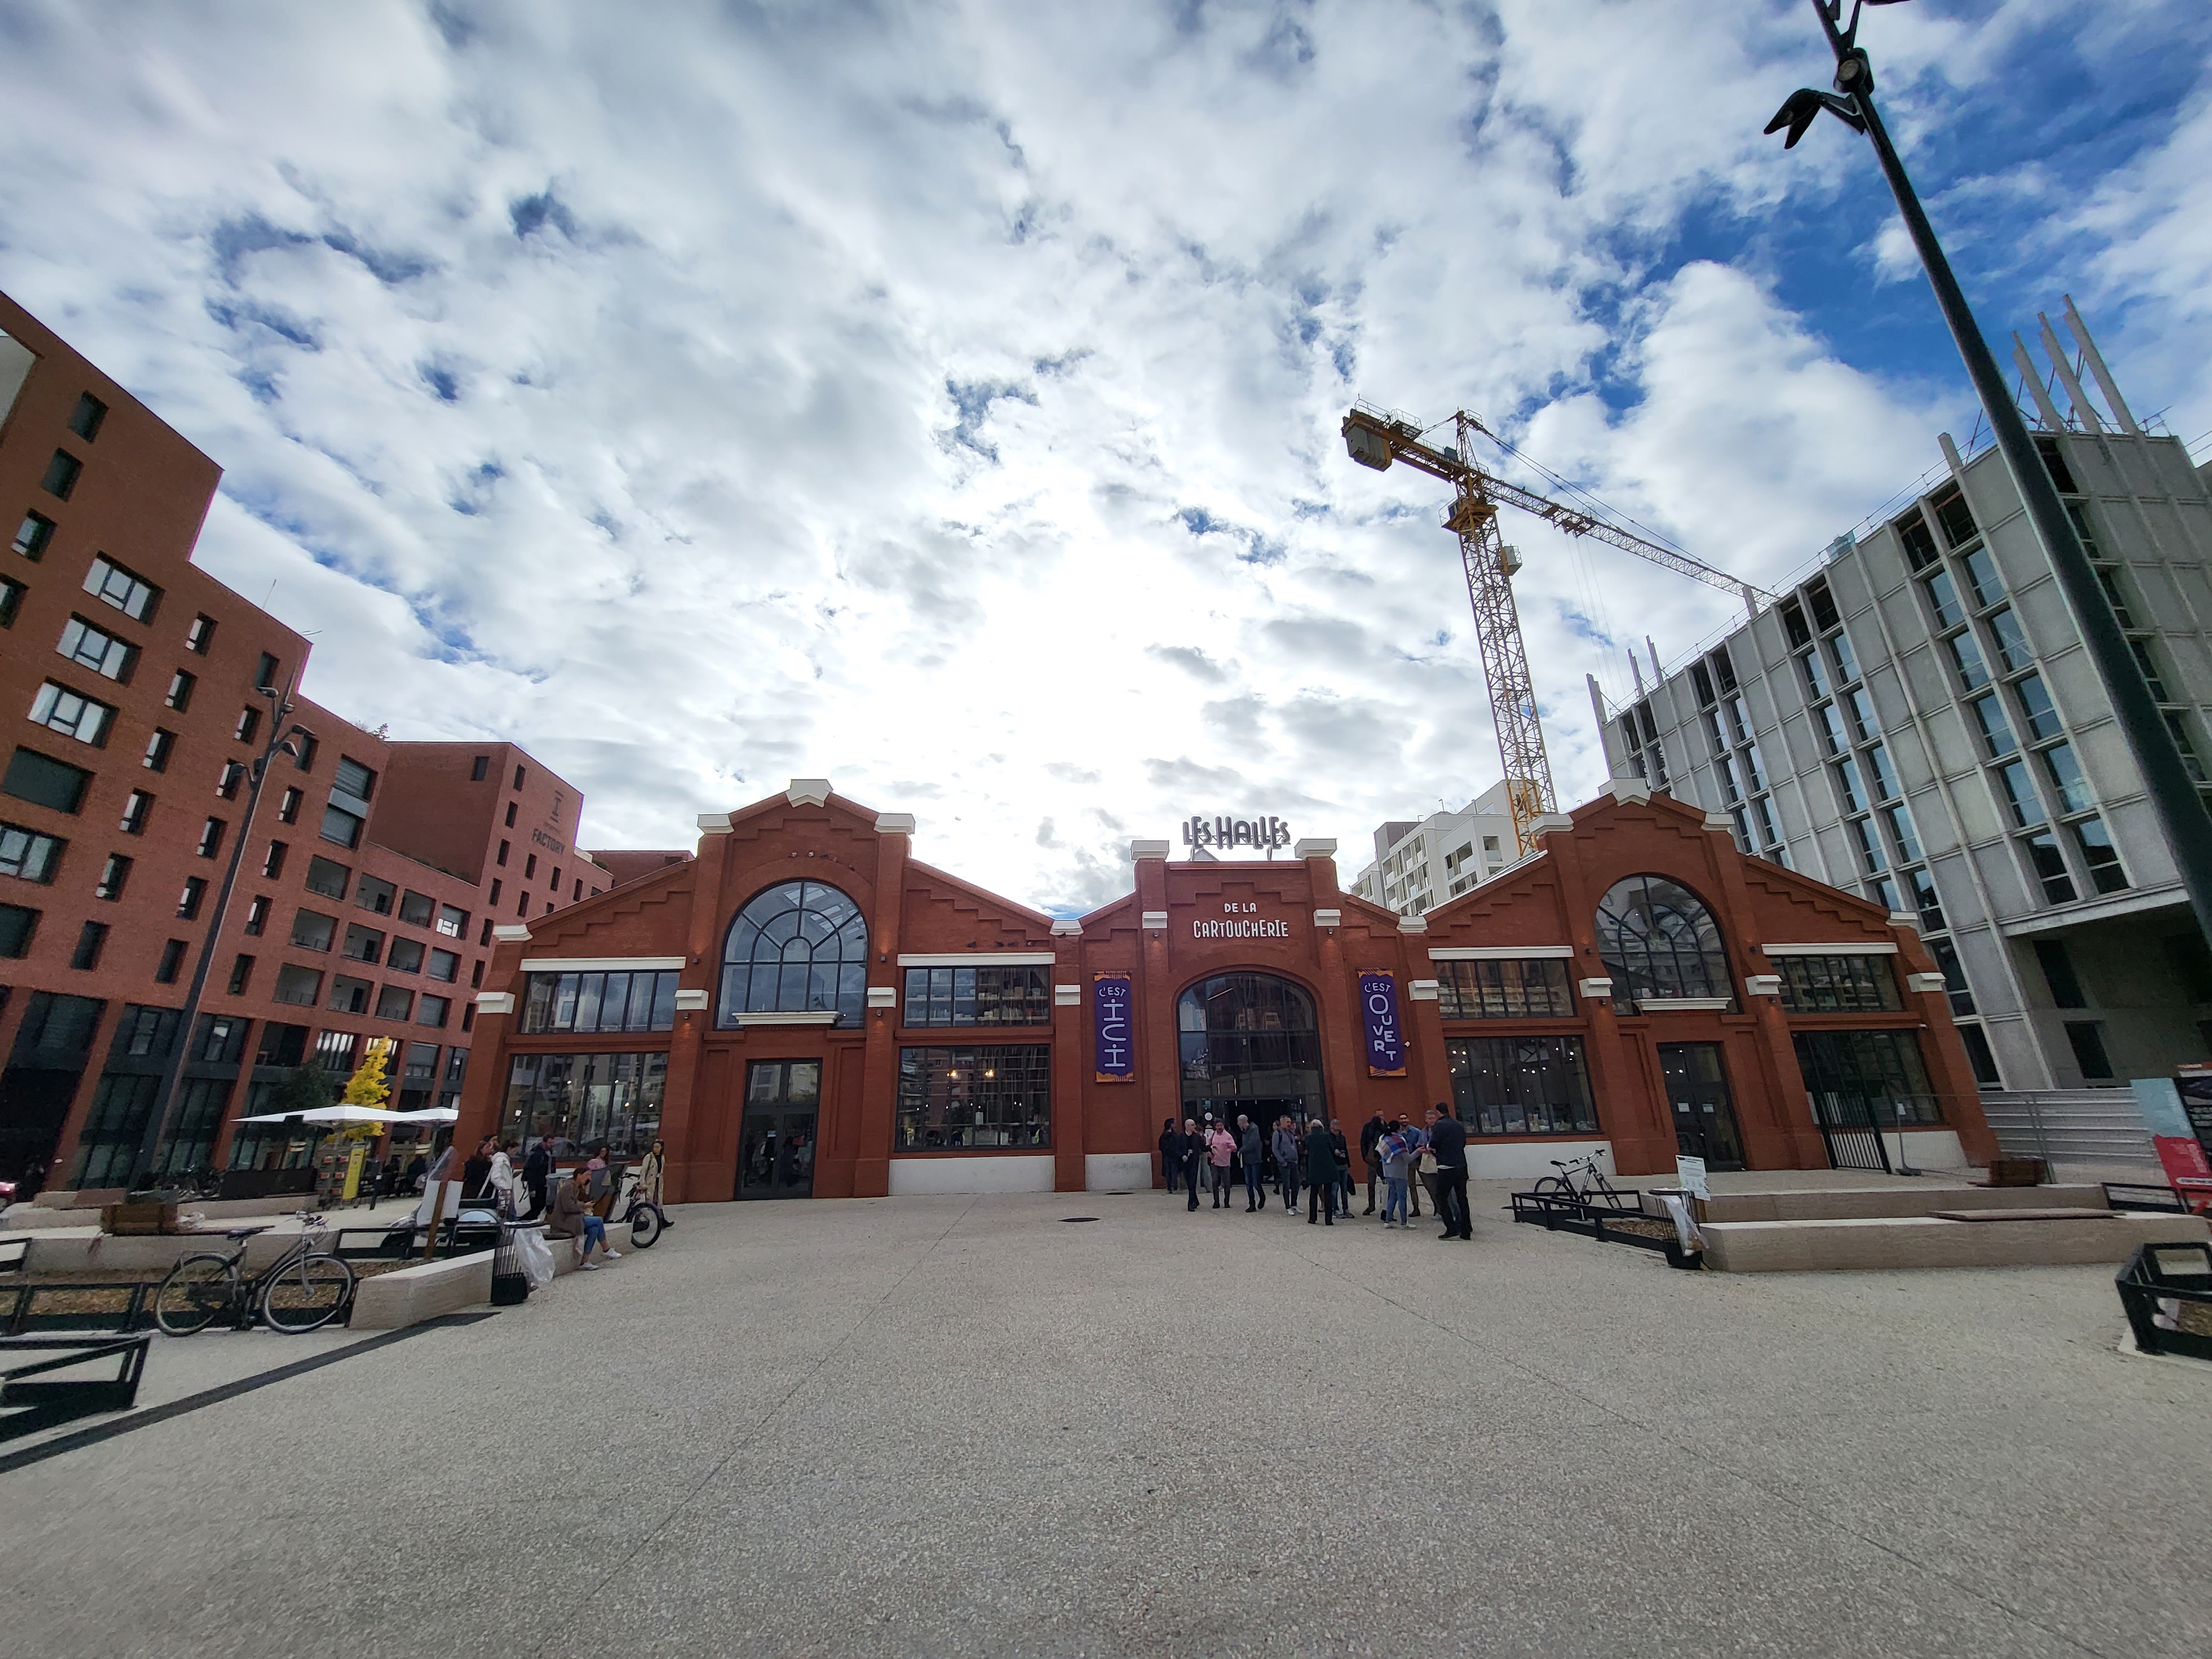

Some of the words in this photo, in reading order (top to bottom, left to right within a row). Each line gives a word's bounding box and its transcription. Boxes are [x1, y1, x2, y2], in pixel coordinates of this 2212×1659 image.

[531, 828, 565, 855] FACTORY
[1182, 816, 1212, 849] LES
[1215, 816, 1291, 849] HALLES
[1224, 903, 1238, 913] DE
[1243, 902, 1257, 913] LA
[1193, 920, 1288, 938] CARTOUCHERIE
[1099, 987, 1126, 997] C'EST
[1364, 983, 1391, 993] C'EST
[1369, 994, 1396, 1061] OUVERT
